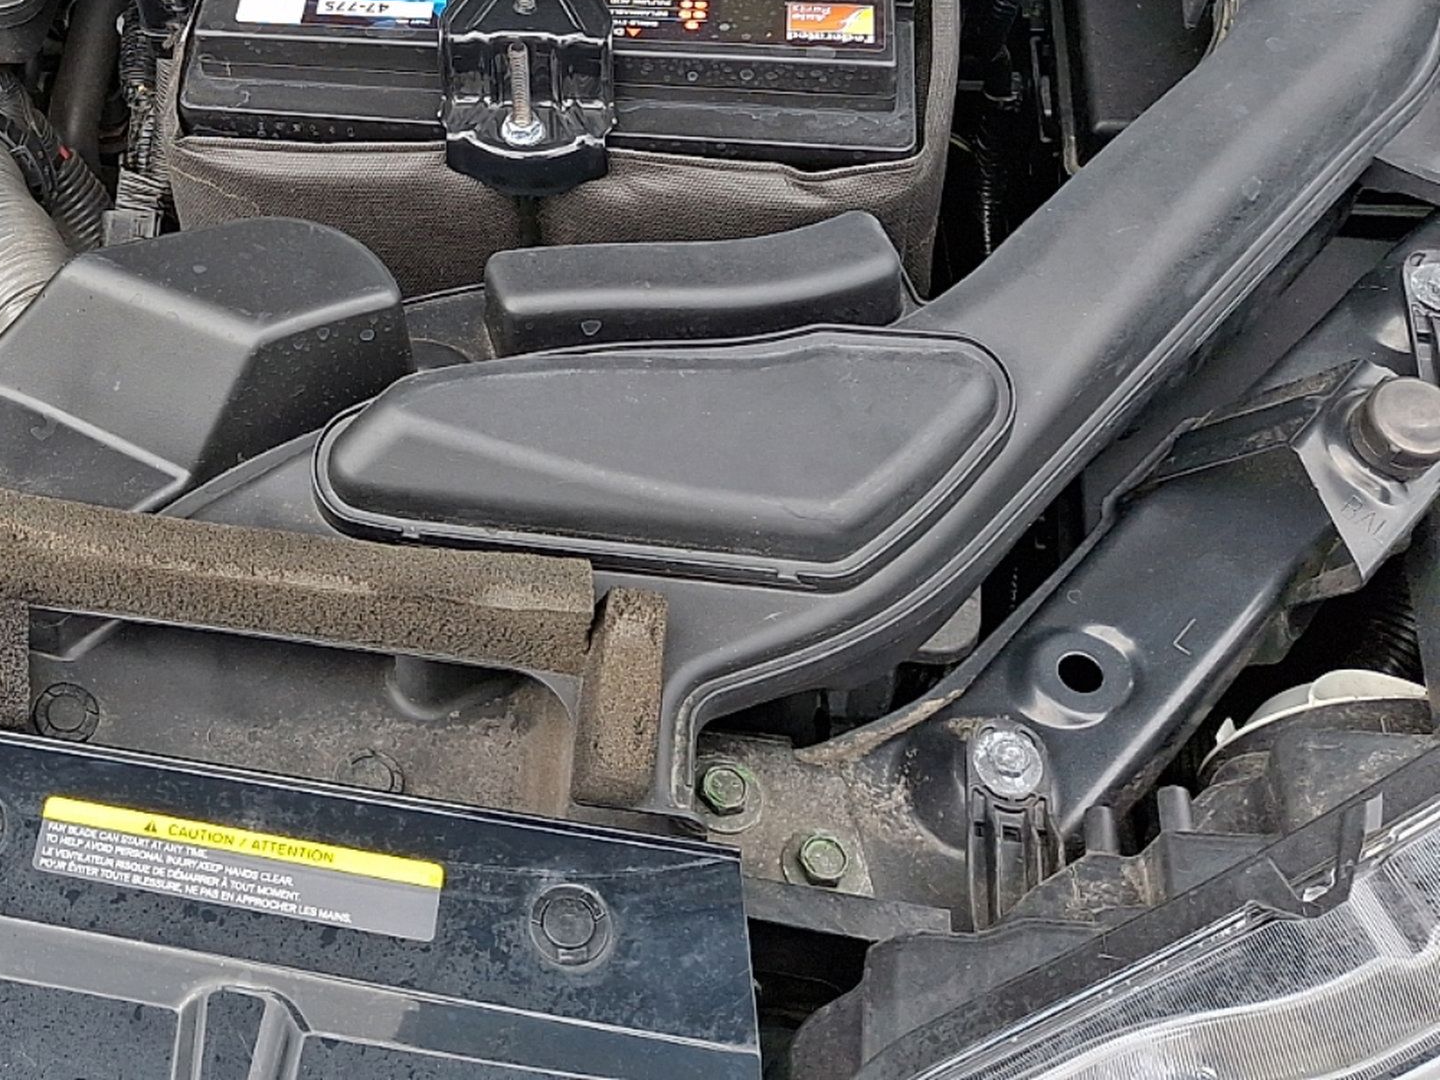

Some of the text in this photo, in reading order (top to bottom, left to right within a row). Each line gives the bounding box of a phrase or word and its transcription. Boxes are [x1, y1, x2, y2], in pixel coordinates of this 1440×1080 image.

[785, 30, 874, 43] Federated
[45, 832, 58, 843] TO
[58, 835, 82, 848] HELP
[83, 839, 114, 853] AVOID
[114, 845, 165, 862] PERSONAL
[223, 865, 258, 879] HANDS
[47, 821, 66, 833] FAN
[66, 824, 97, 838] BLADE
[98, 830, 119, 842] CAN
[120, 834, 149, 848] START
[149, 839, 162, 850] AT
[162, 842, 183, 854] ANY
[167, 823, 234, 845] CAUTION
[250, 838, 335, 863] ATTENTION
[38, 857, 66, 870] POUR
[67, 860, 100, 876] ÉVITER
[99, 868, 130, 882] TOUTE
[184, 883, 199, 895] NE
[199, 886, 219, 898] PAS
[220, 890, 234, 901] EN
[235, 893, 297, 913] APPROCHER
[297, 904, 317, 916] LES
[41, 845, 54, 856] LE
[54, 847, 114, 867] VENTILATEUR
[115, 858, 151, 874] RISQUE
[151, 865, 166, 876] DE
[166, 865, 220, 886] DÉMARRER
[220, 875, 229, 888] À
[228, 879, 255, 893] TOUT
